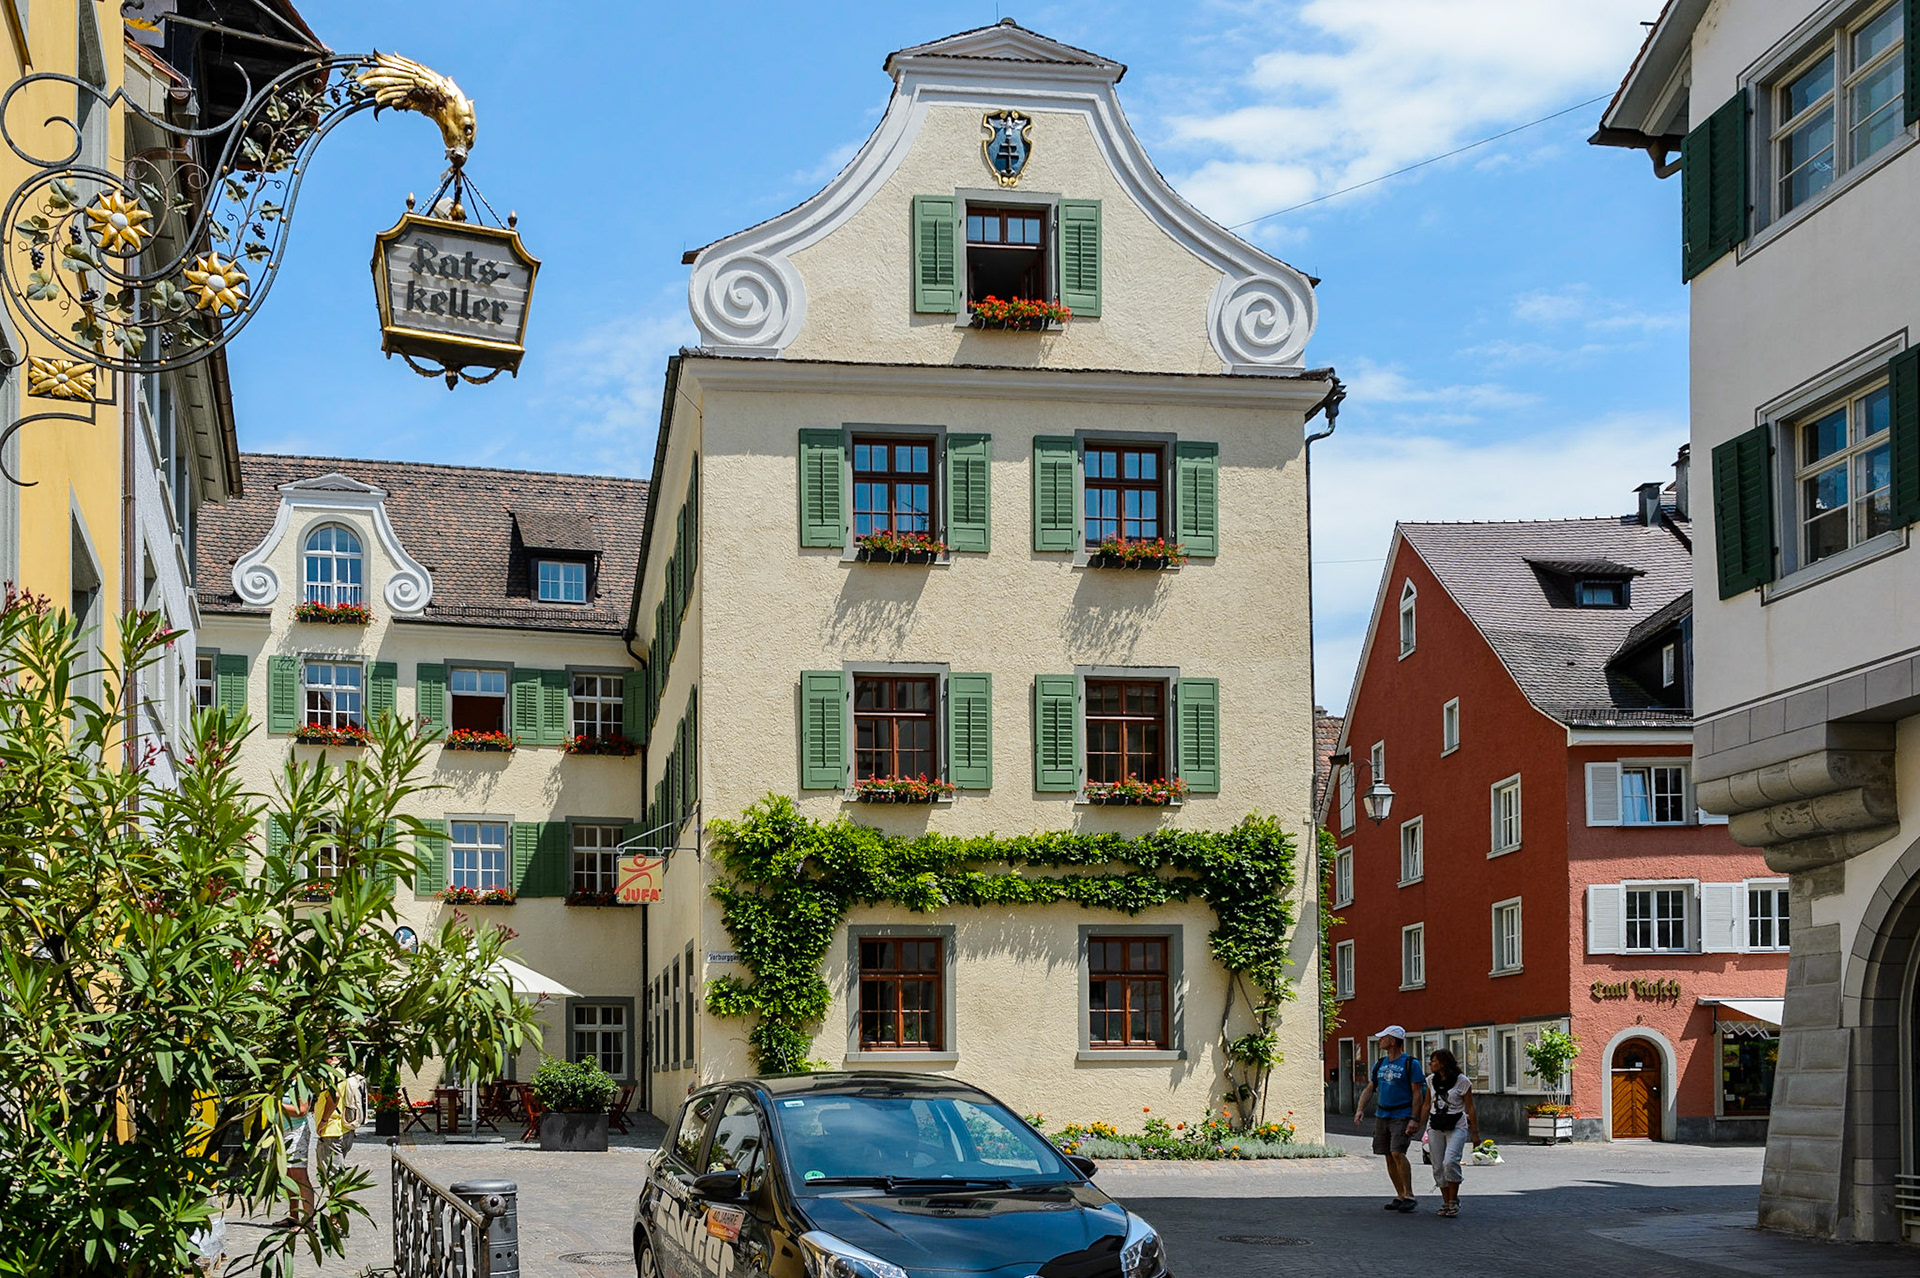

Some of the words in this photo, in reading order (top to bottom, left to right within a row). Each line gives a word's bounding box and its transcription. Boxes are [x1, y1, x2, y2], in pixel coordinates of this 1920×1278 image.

[409, 238, 510, 285] Rats-
[623, 888, 659, 901] JUFA
[1592, 980, 1629, 998] Emil
